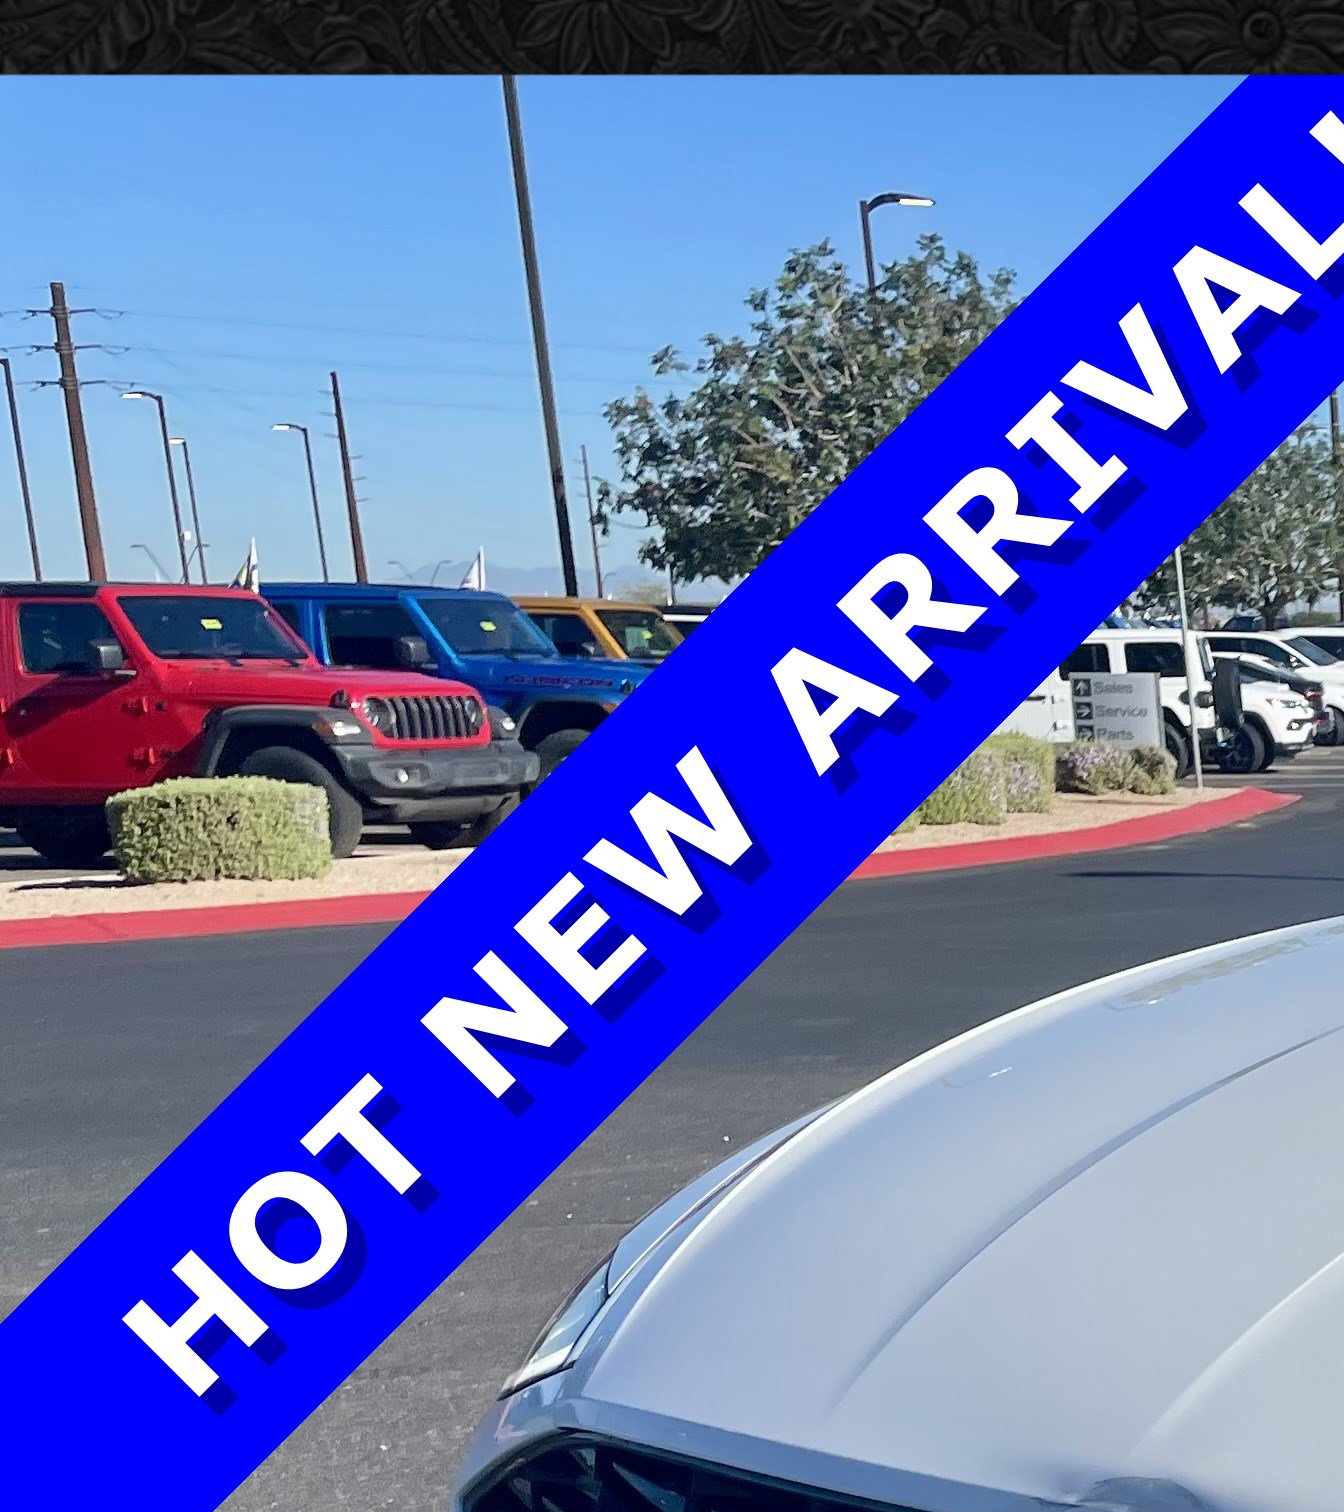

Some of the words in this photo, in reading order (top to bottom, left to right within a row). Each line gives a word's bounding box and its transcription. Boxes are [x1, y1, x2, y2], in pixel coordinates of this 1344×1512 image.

[1093, 681, 1134, 695] Sales
[1095, 704, 1148, 718] Service
[1097, 727, 1134, 741] Parts
